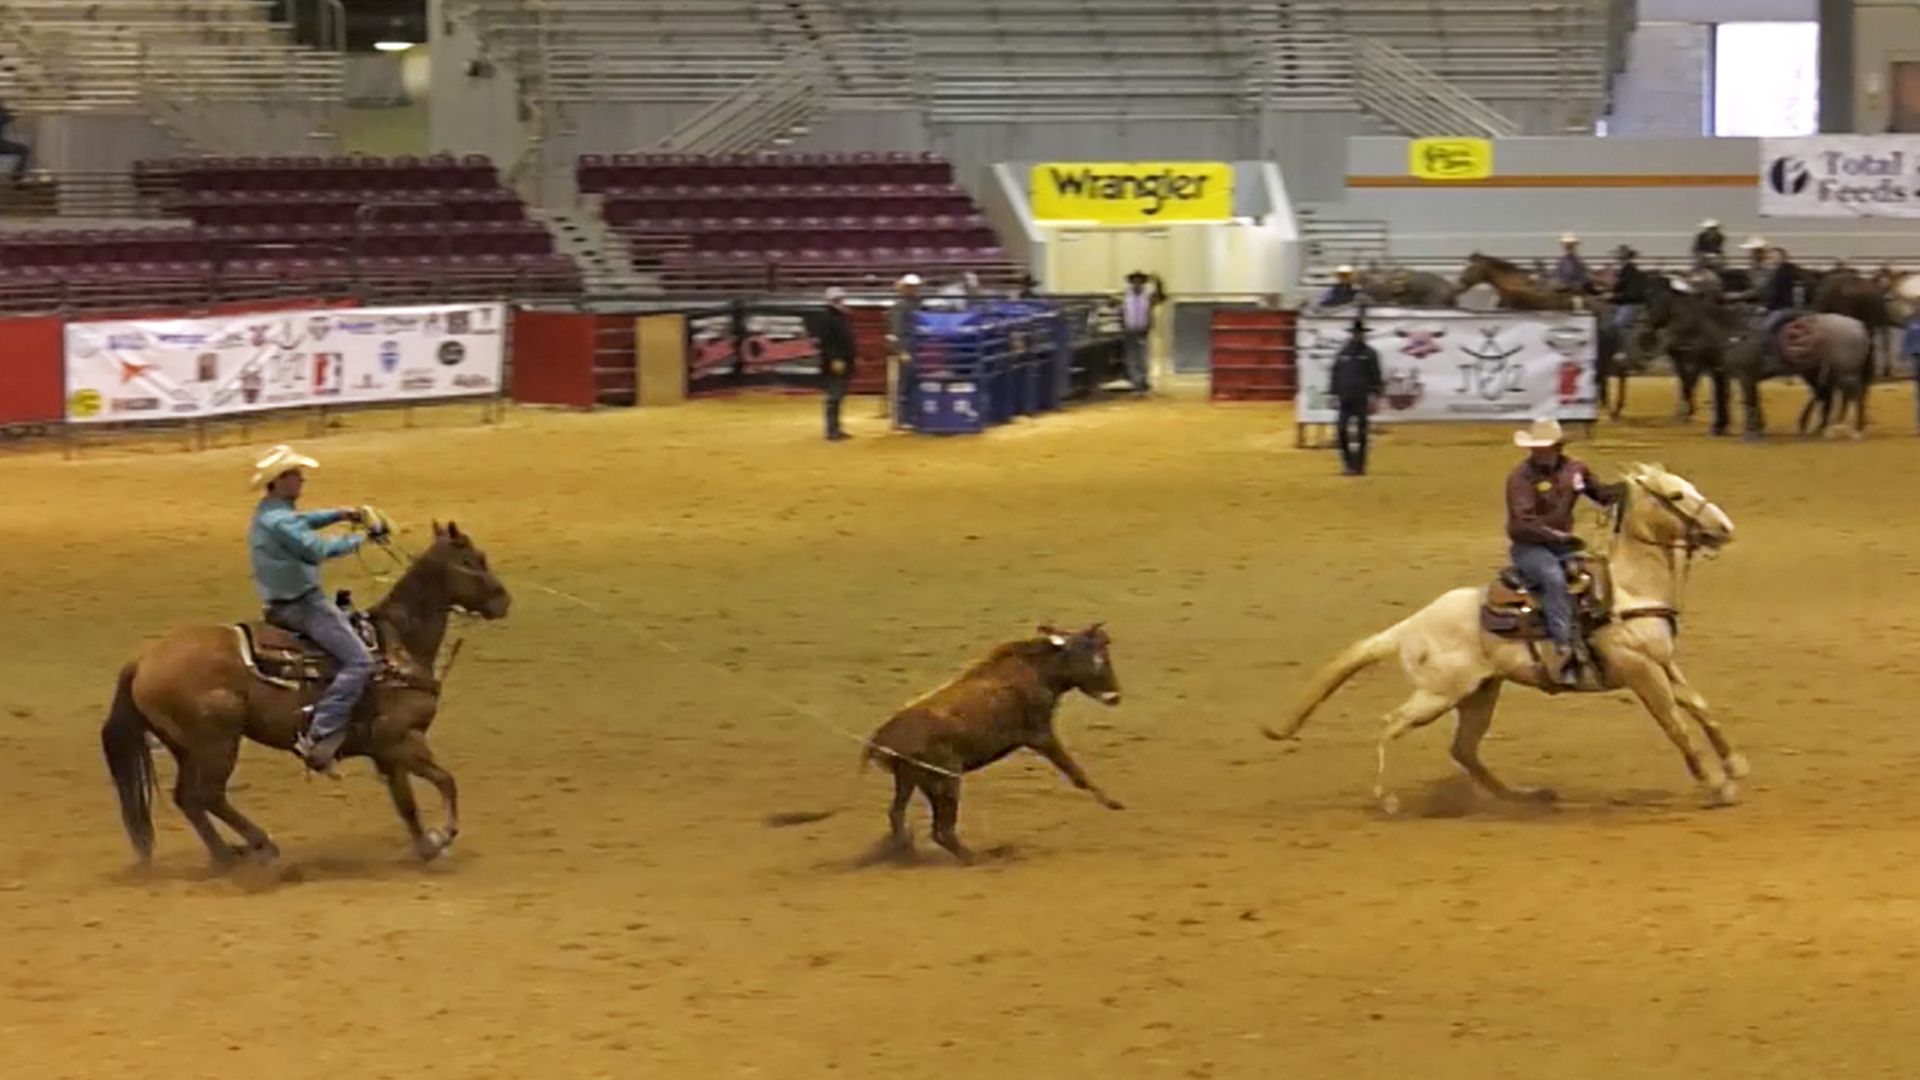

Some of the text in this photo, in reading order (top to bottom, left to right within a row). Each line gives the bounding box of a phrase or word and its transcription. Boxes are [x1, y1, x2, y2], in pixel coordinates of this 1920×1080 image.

[1820, 151, 1902, 175] Total
[1050, 168, 1208, 215] Wrangler
[1818, 178, 1907, 203] Feeds
